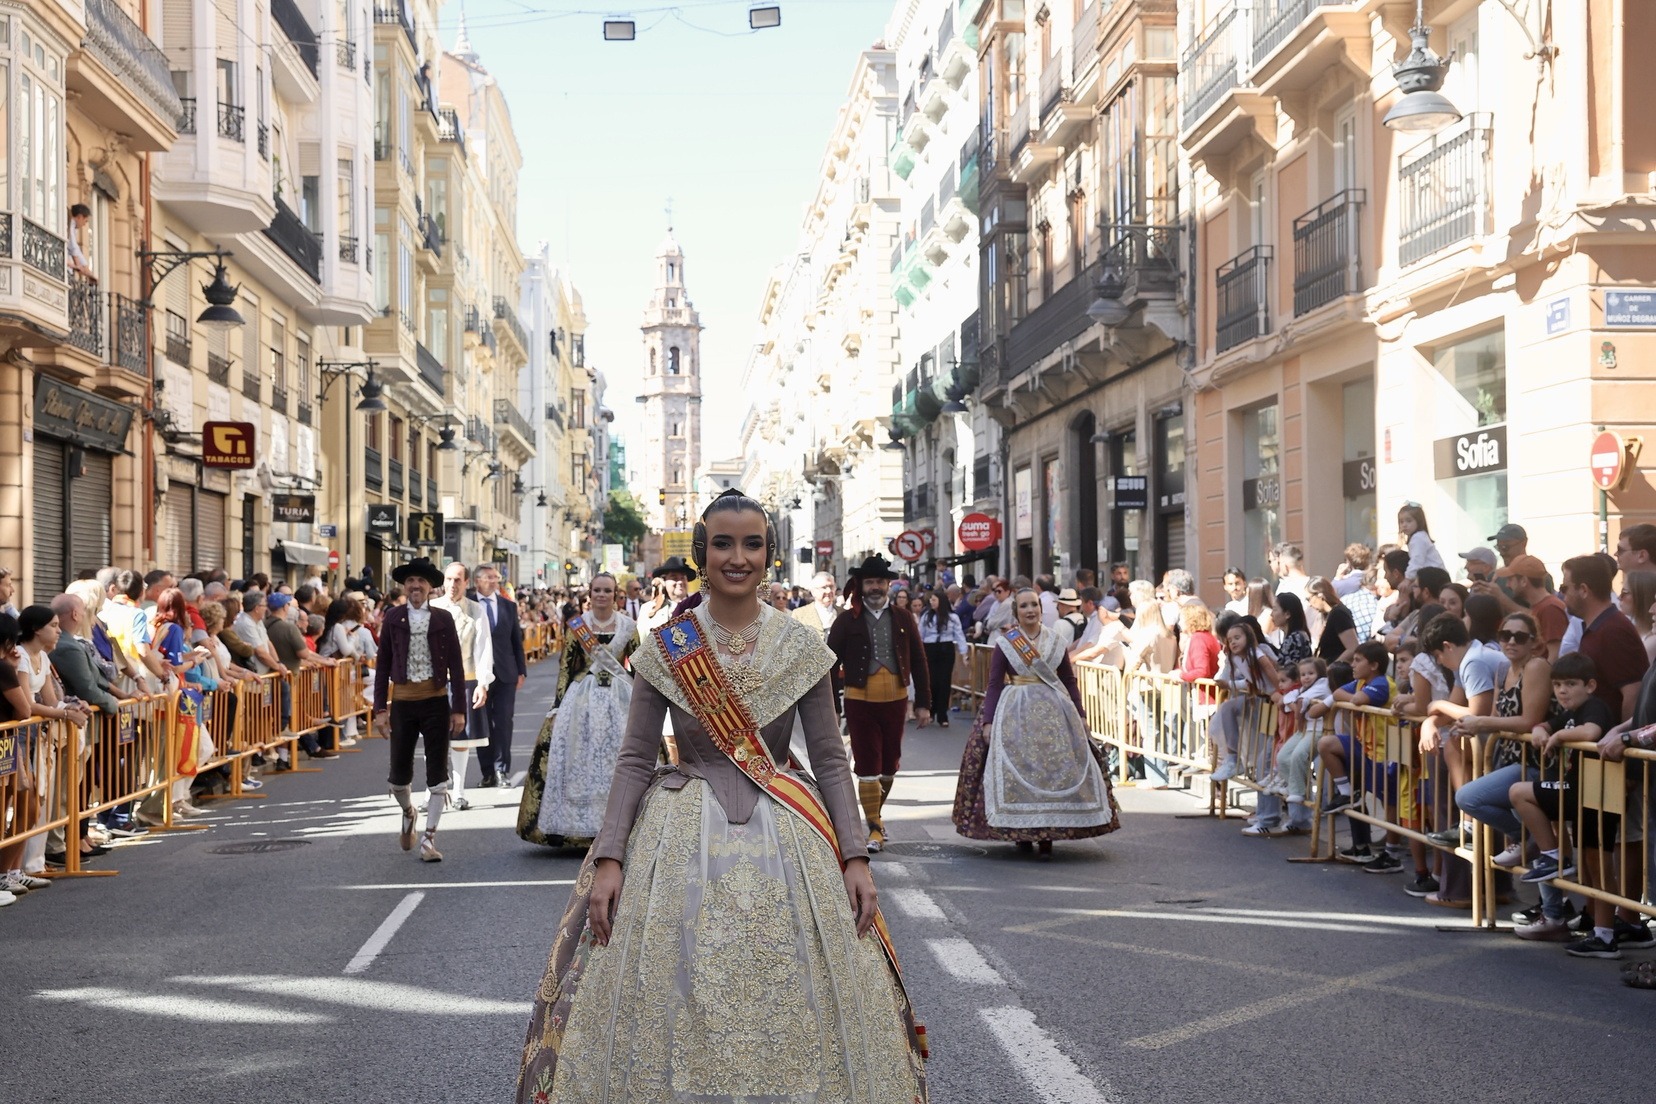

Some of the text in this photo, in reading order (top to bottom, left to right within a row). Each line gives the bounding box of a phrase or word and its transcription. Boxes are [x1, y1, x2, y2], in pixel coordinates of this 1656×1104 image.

[1607, 313, 1630, 323] MUÑOZ
[1457, 433, 1499, 470] Sofia
[206, 455, 251, 464] TABACOS
[1257, 479, 1280, 504] Sofia
[279, 507, 310, 516] TURIA
[962, 522, 990, 531] suma
